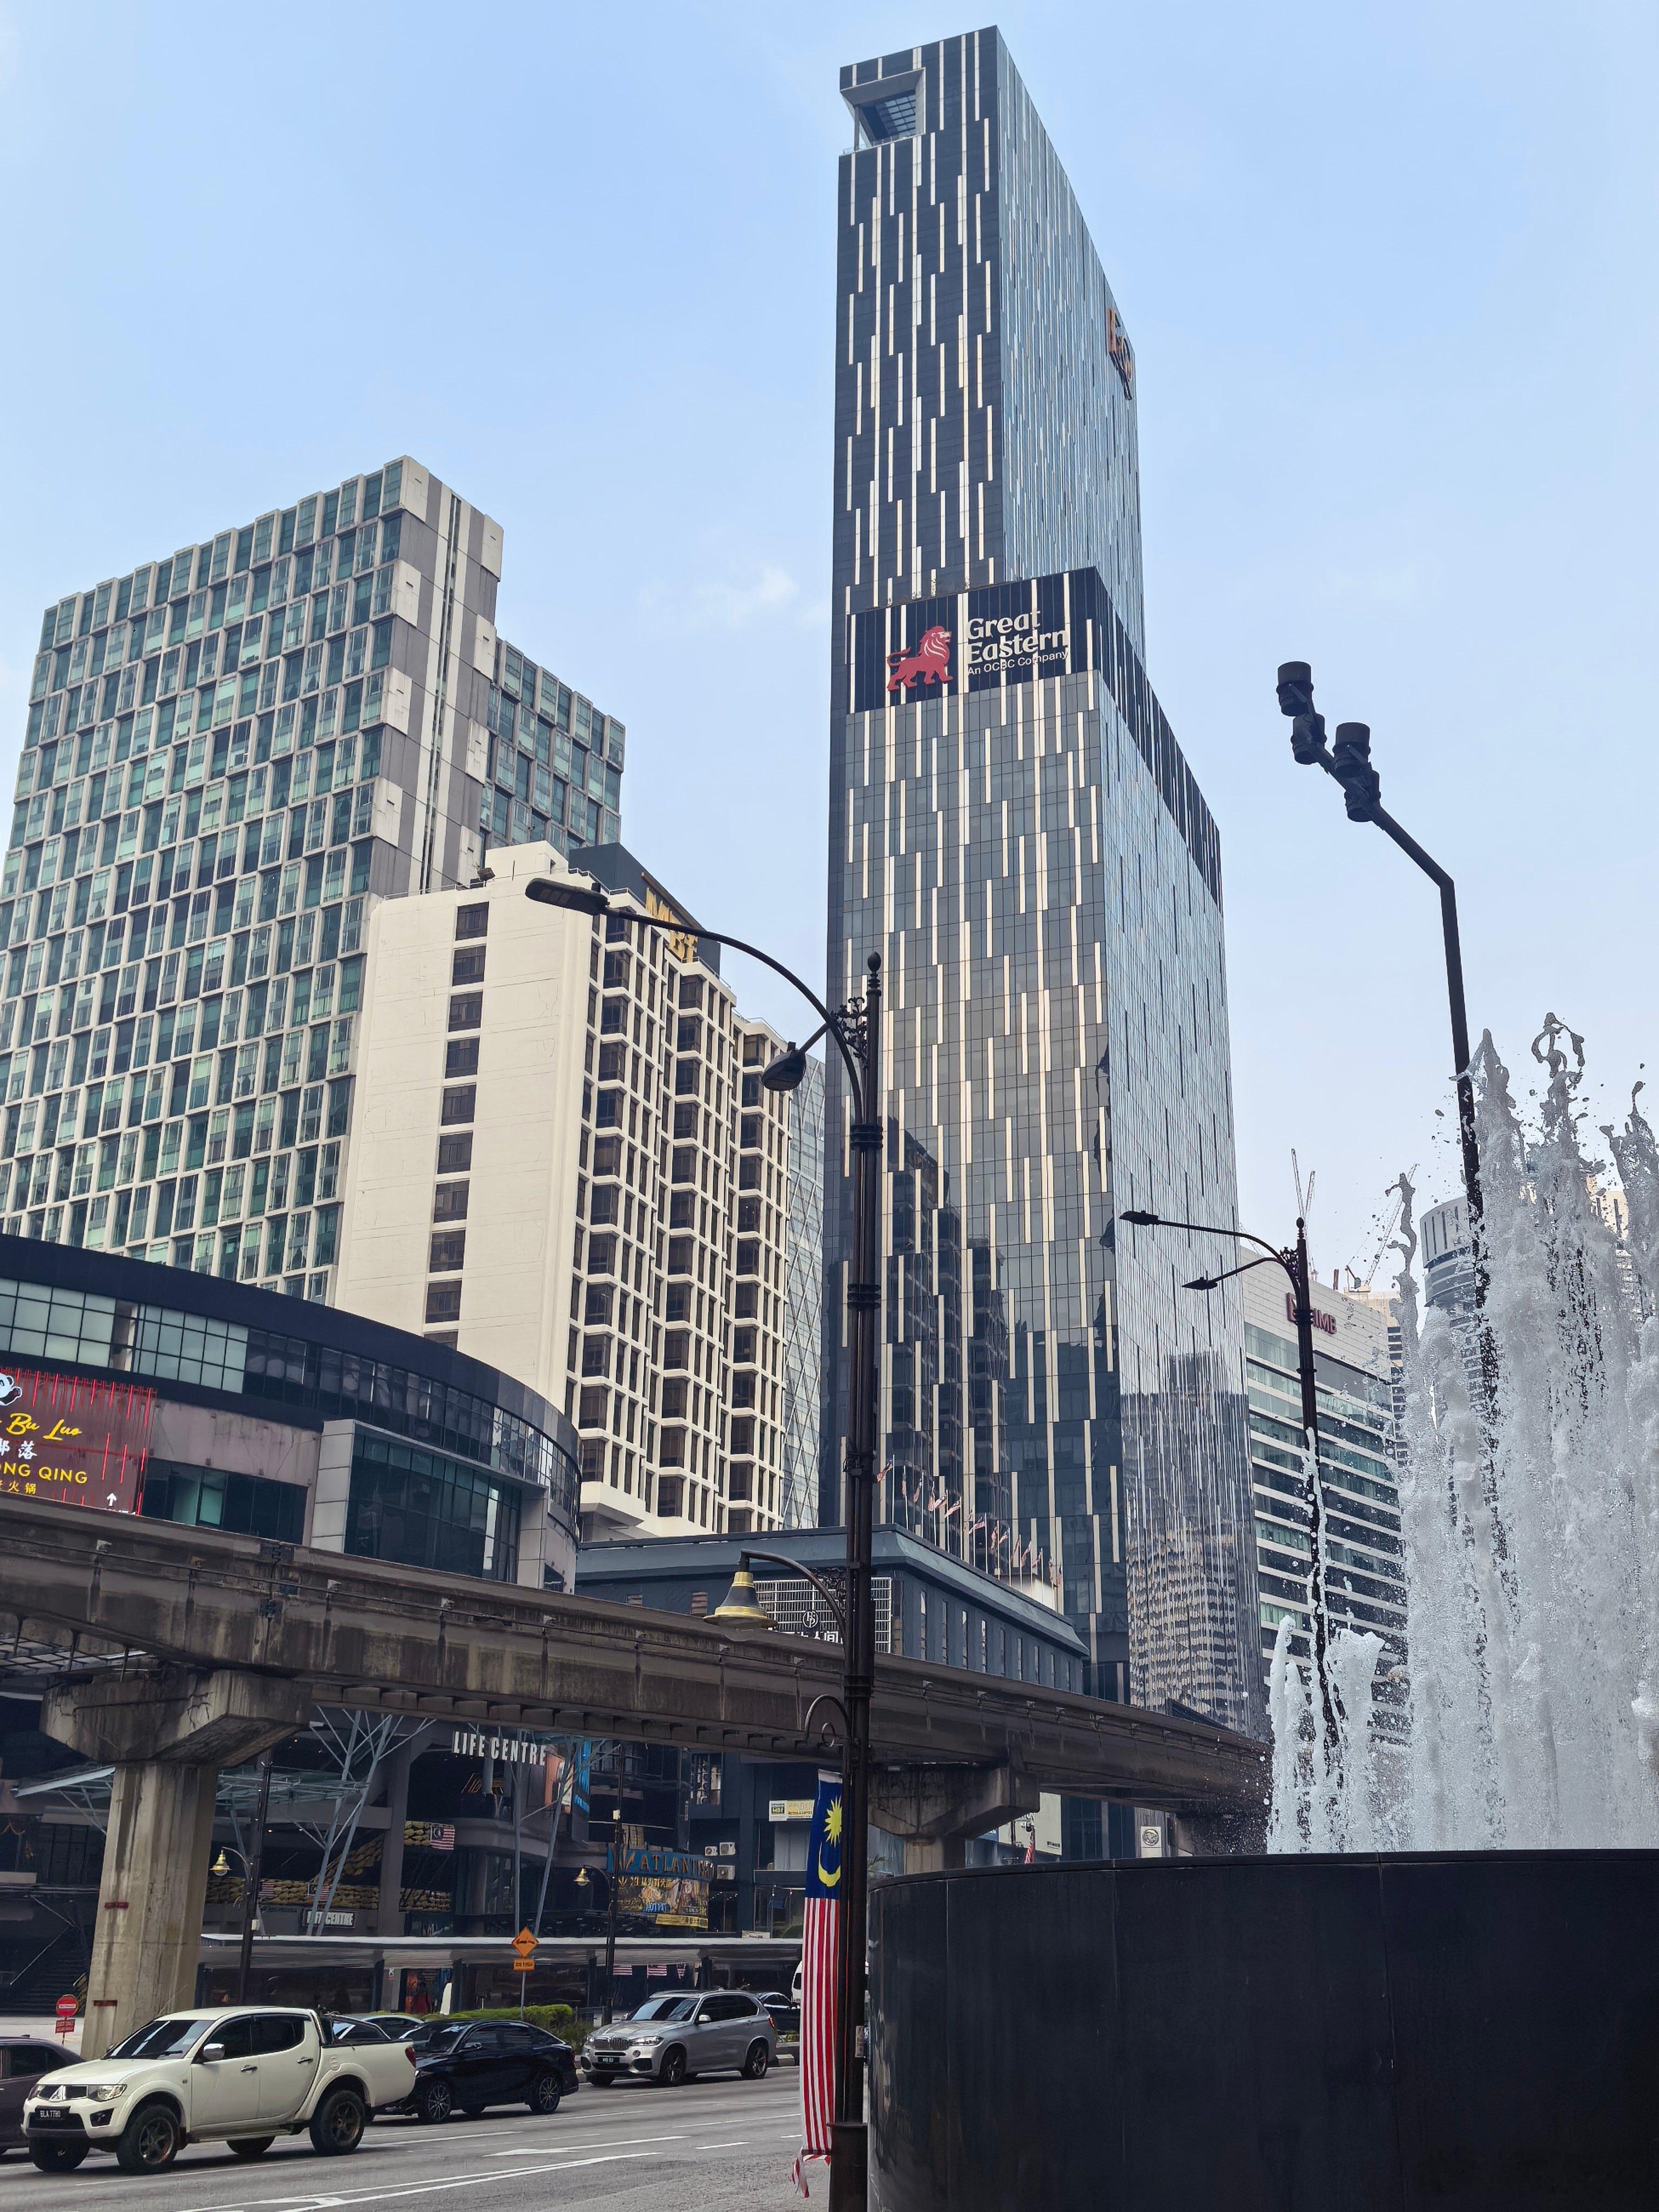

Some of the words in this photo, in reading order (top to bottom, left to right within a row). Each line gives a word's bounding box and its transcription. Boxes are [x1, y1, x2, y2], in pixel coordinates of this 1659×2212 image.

[967, 609, 1041, 639] Great
[967, 630, 1068, 664] Eastern
[968, 666, 981, 676] An
[983, 659, 1015, 673] OCBC
[1017, 651, 1068, 665] Company
[6, 1413, 40, 1435] Bu
[43, 1419, 82, 1441] Luo
[0, 1461, 31, 1477] NG
[38, 1466, 87, 1483] QING
[453, 1731, 485, 1757] LIFE
[490, 1737, 547, 1766] CENTRE
